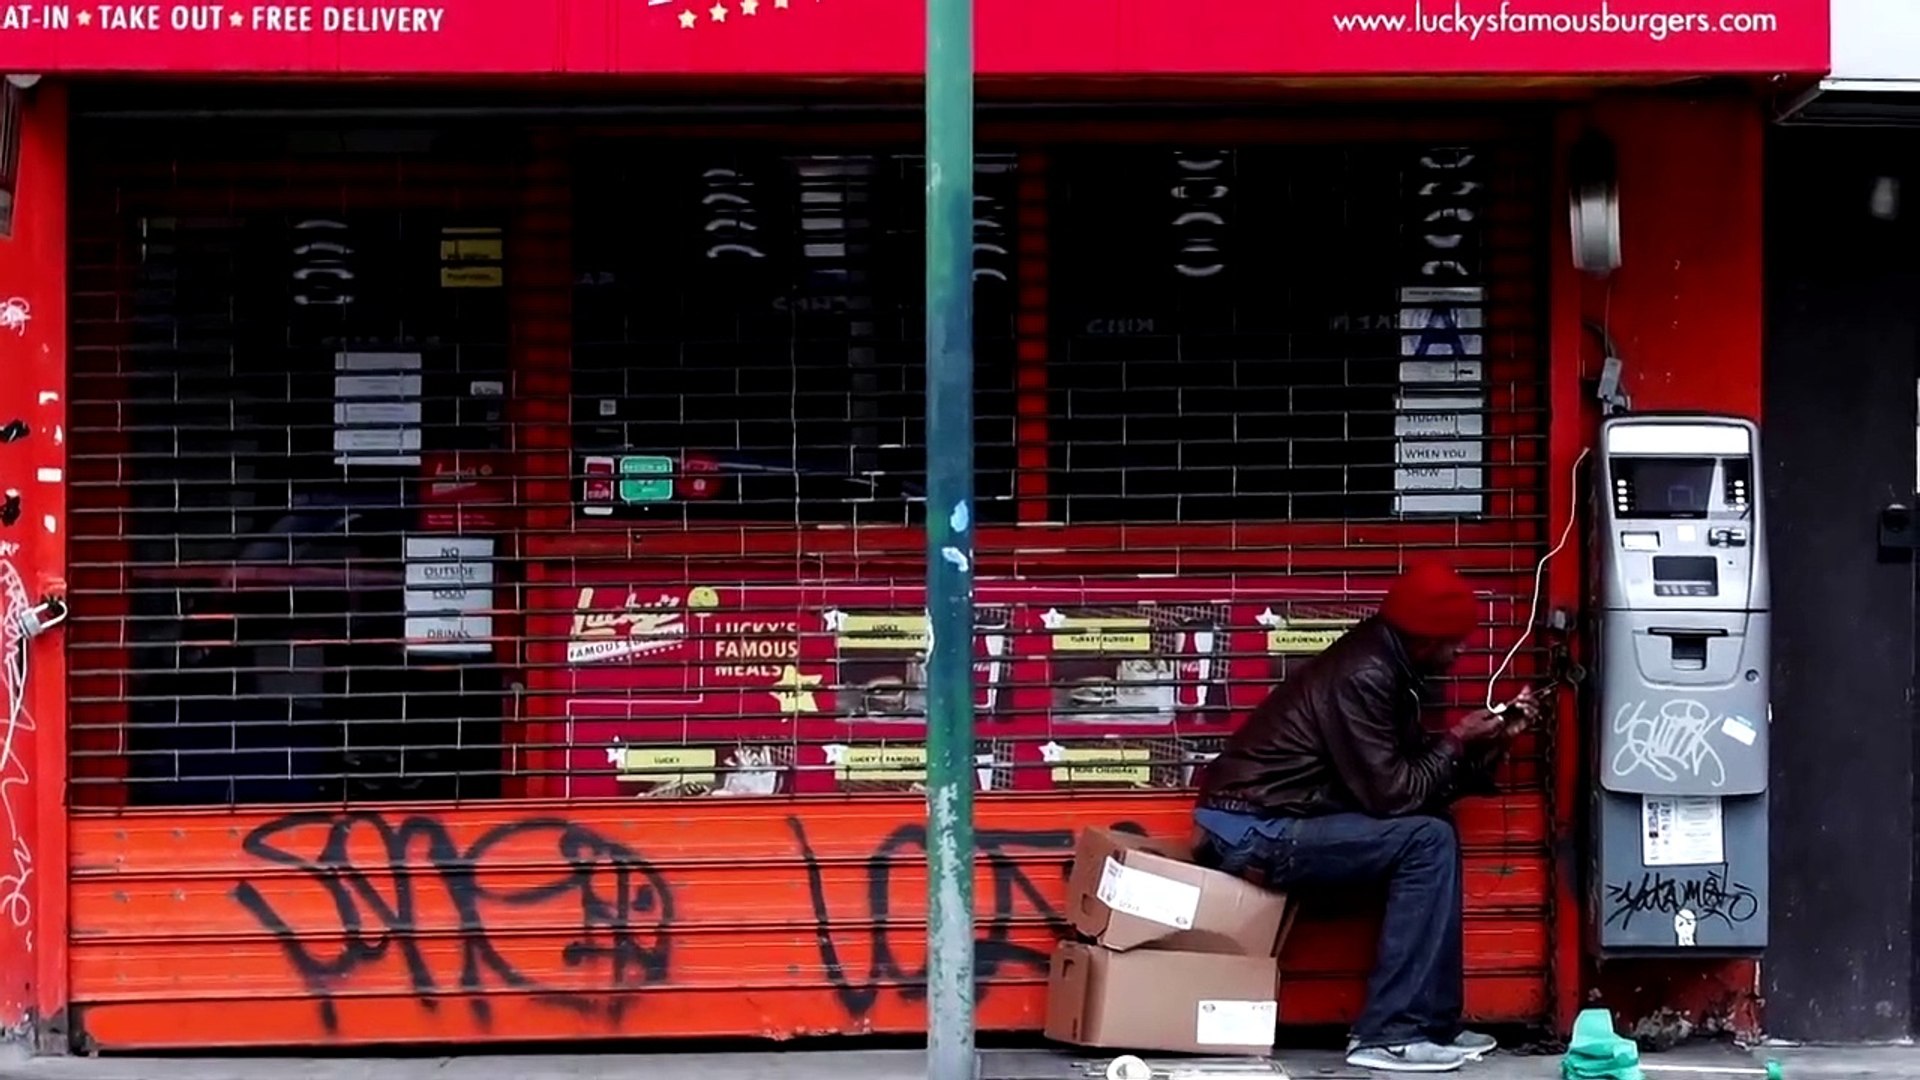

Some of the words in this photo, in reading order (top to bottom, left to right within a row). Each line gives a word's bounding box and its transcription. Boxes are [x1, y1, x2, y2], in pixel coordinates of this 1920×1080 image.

[0, 5, 69, 29] AT-IN
[98, 5, 160, 30] TAKE
[171, 5, 223, 30] OUT
[252, 6, 312, 31] FREE
[323, 7, 444, 32] DELIVERY
[1333, 0, 1777, 40] www.luckysfamousburgers.com
[1416, 305, 1465, 356] A
[1404, 449, 1439, 459] WHEN
[1443, 449, 1466, 458] YOU
[441, 547, 460, 558] NO
[715, 641, 798, 658] FAMOUS
